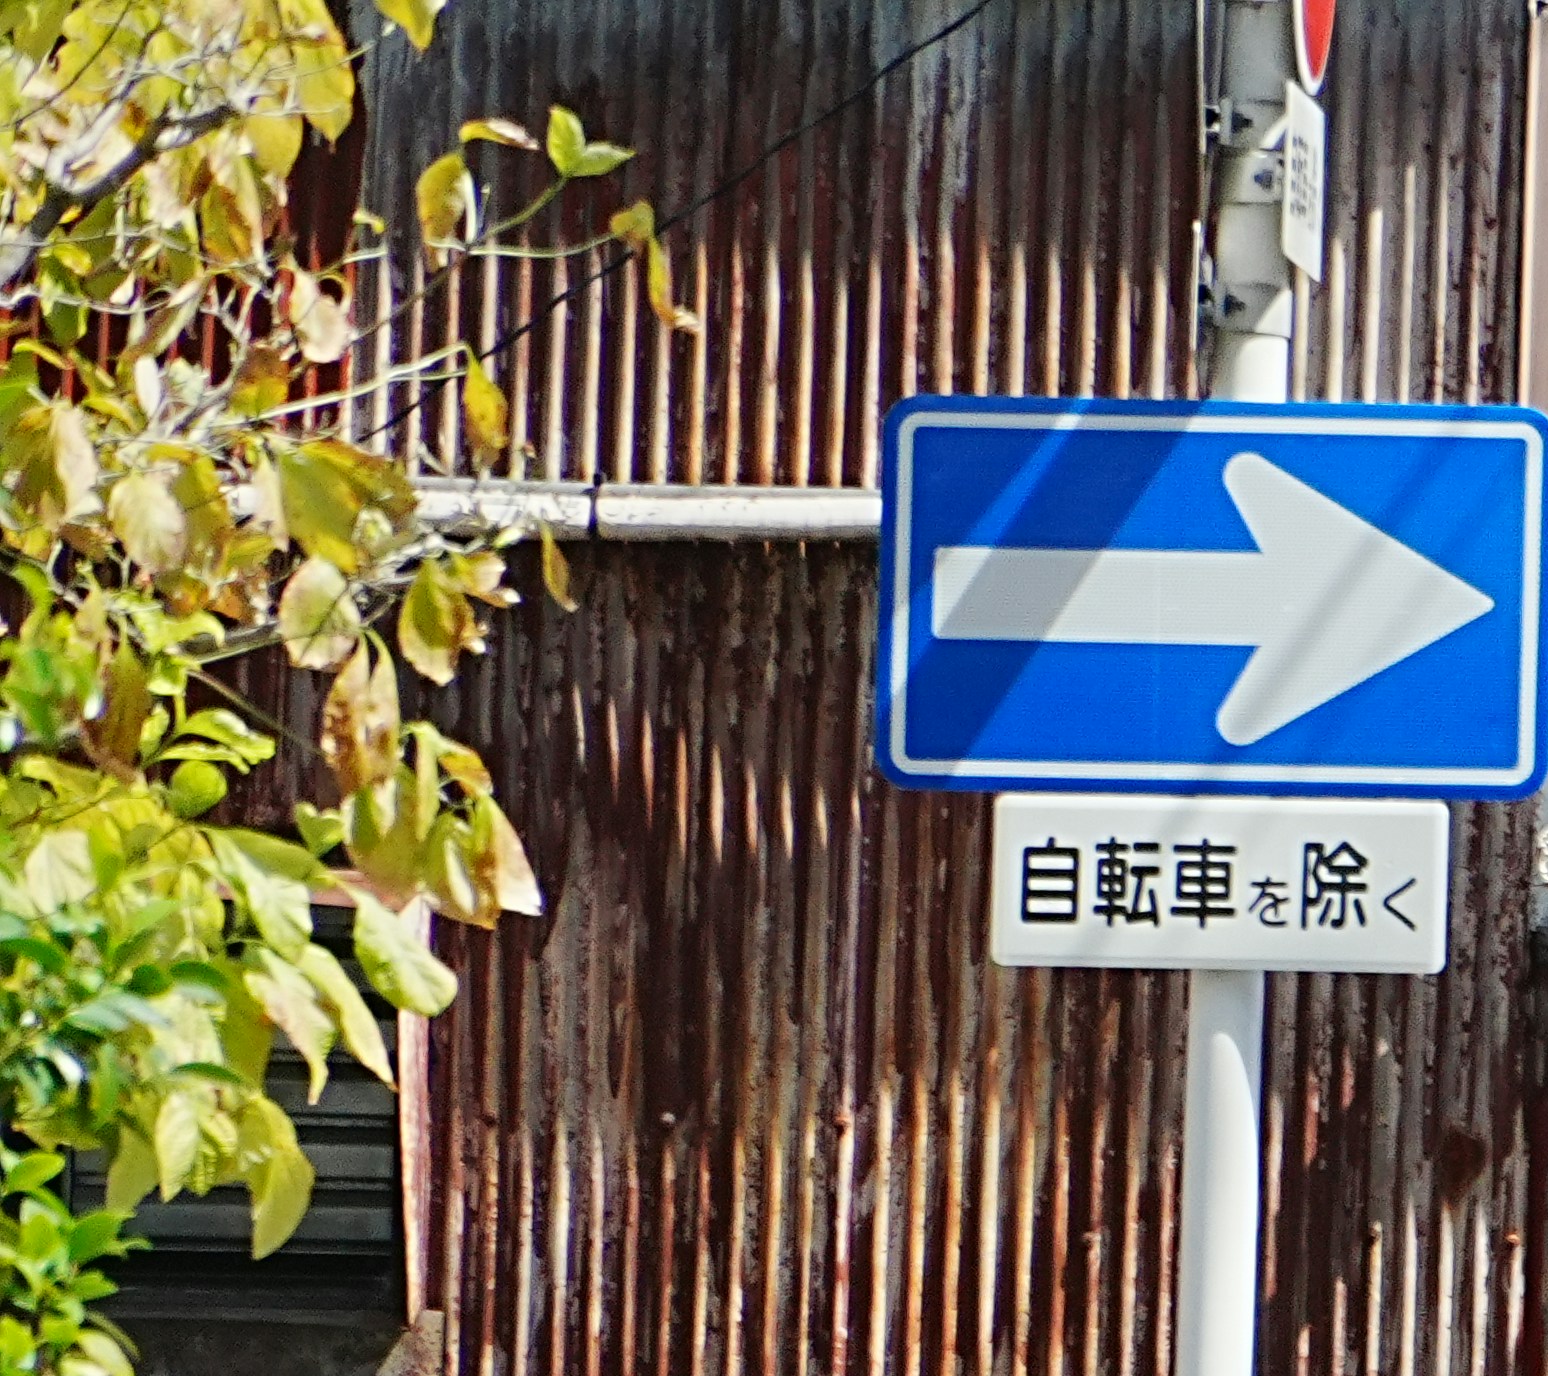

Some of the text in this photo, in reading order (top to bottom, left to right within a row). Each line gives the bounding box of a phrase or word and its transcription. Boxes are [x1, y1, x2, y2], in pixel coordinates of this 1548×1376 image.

[1020, 836, 1416, 931] 自転車を除く
